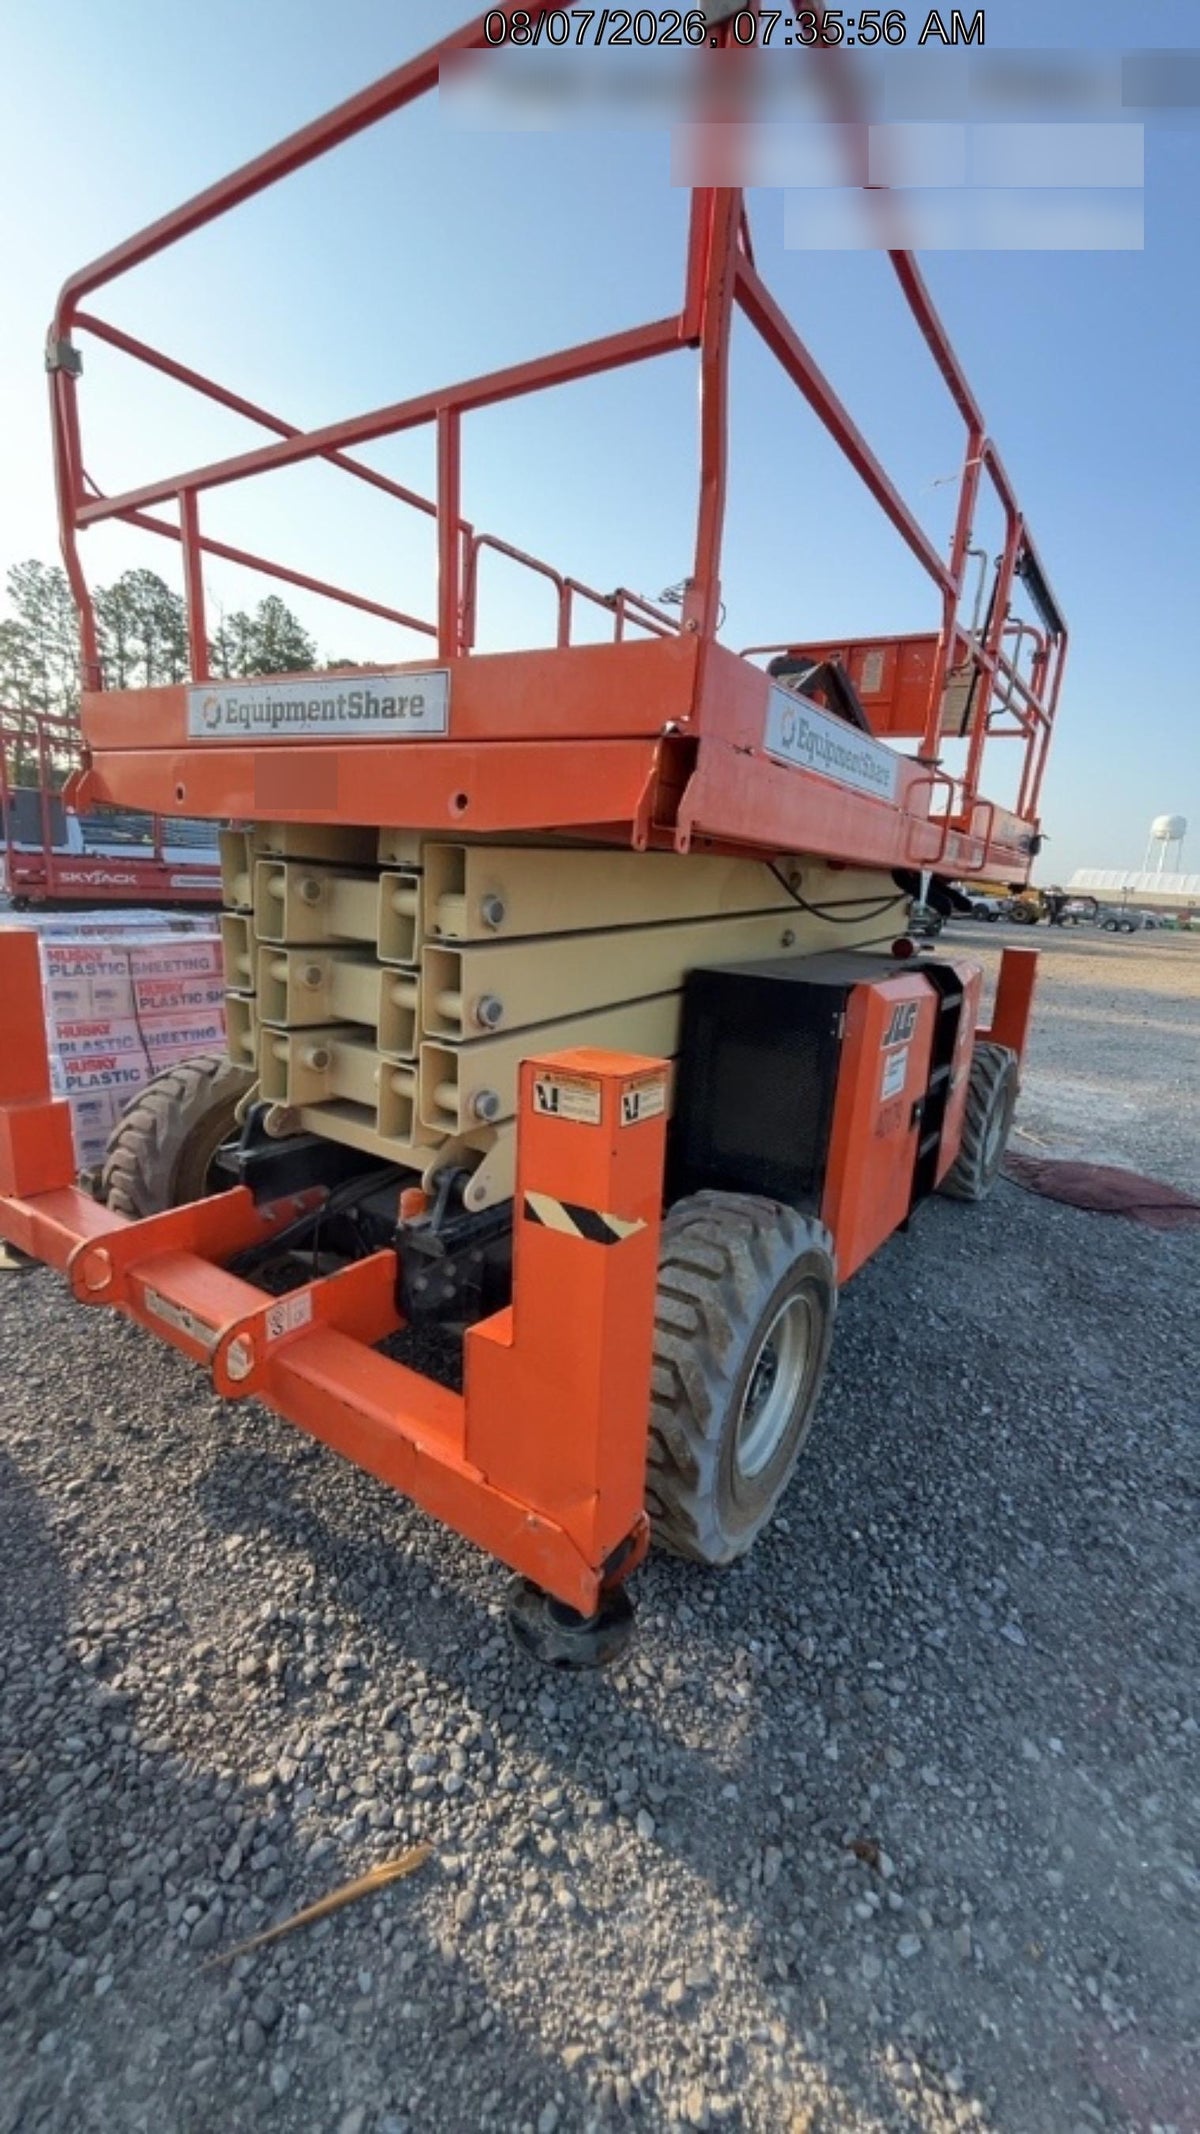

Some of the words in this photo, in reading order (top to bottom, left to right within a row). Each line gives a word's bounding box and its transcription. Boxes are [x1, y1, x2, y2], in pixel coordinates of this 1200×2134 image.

[225, 690, 425, 729] EquipmentShare
[797, 717, 891, 787] EquipmentShare
[59, 869, 138, 885] SKYJACK
[47, 948, 103, 963] HUSKY
[49, 961, 127, 977] PLASTIC
[131, 958, 209, 974] SHEETING
[137, 981, 185, 997] HUSKY
[139, 990, 203, 1009] PLASTIC
[55, 1022, 112, 1039] HUSKY
[883, 1002, 918, 1046] JLG
[63, 1056, 117, 1075] HUSKY
[65, 1068, 141, 1090] PLASTIC
